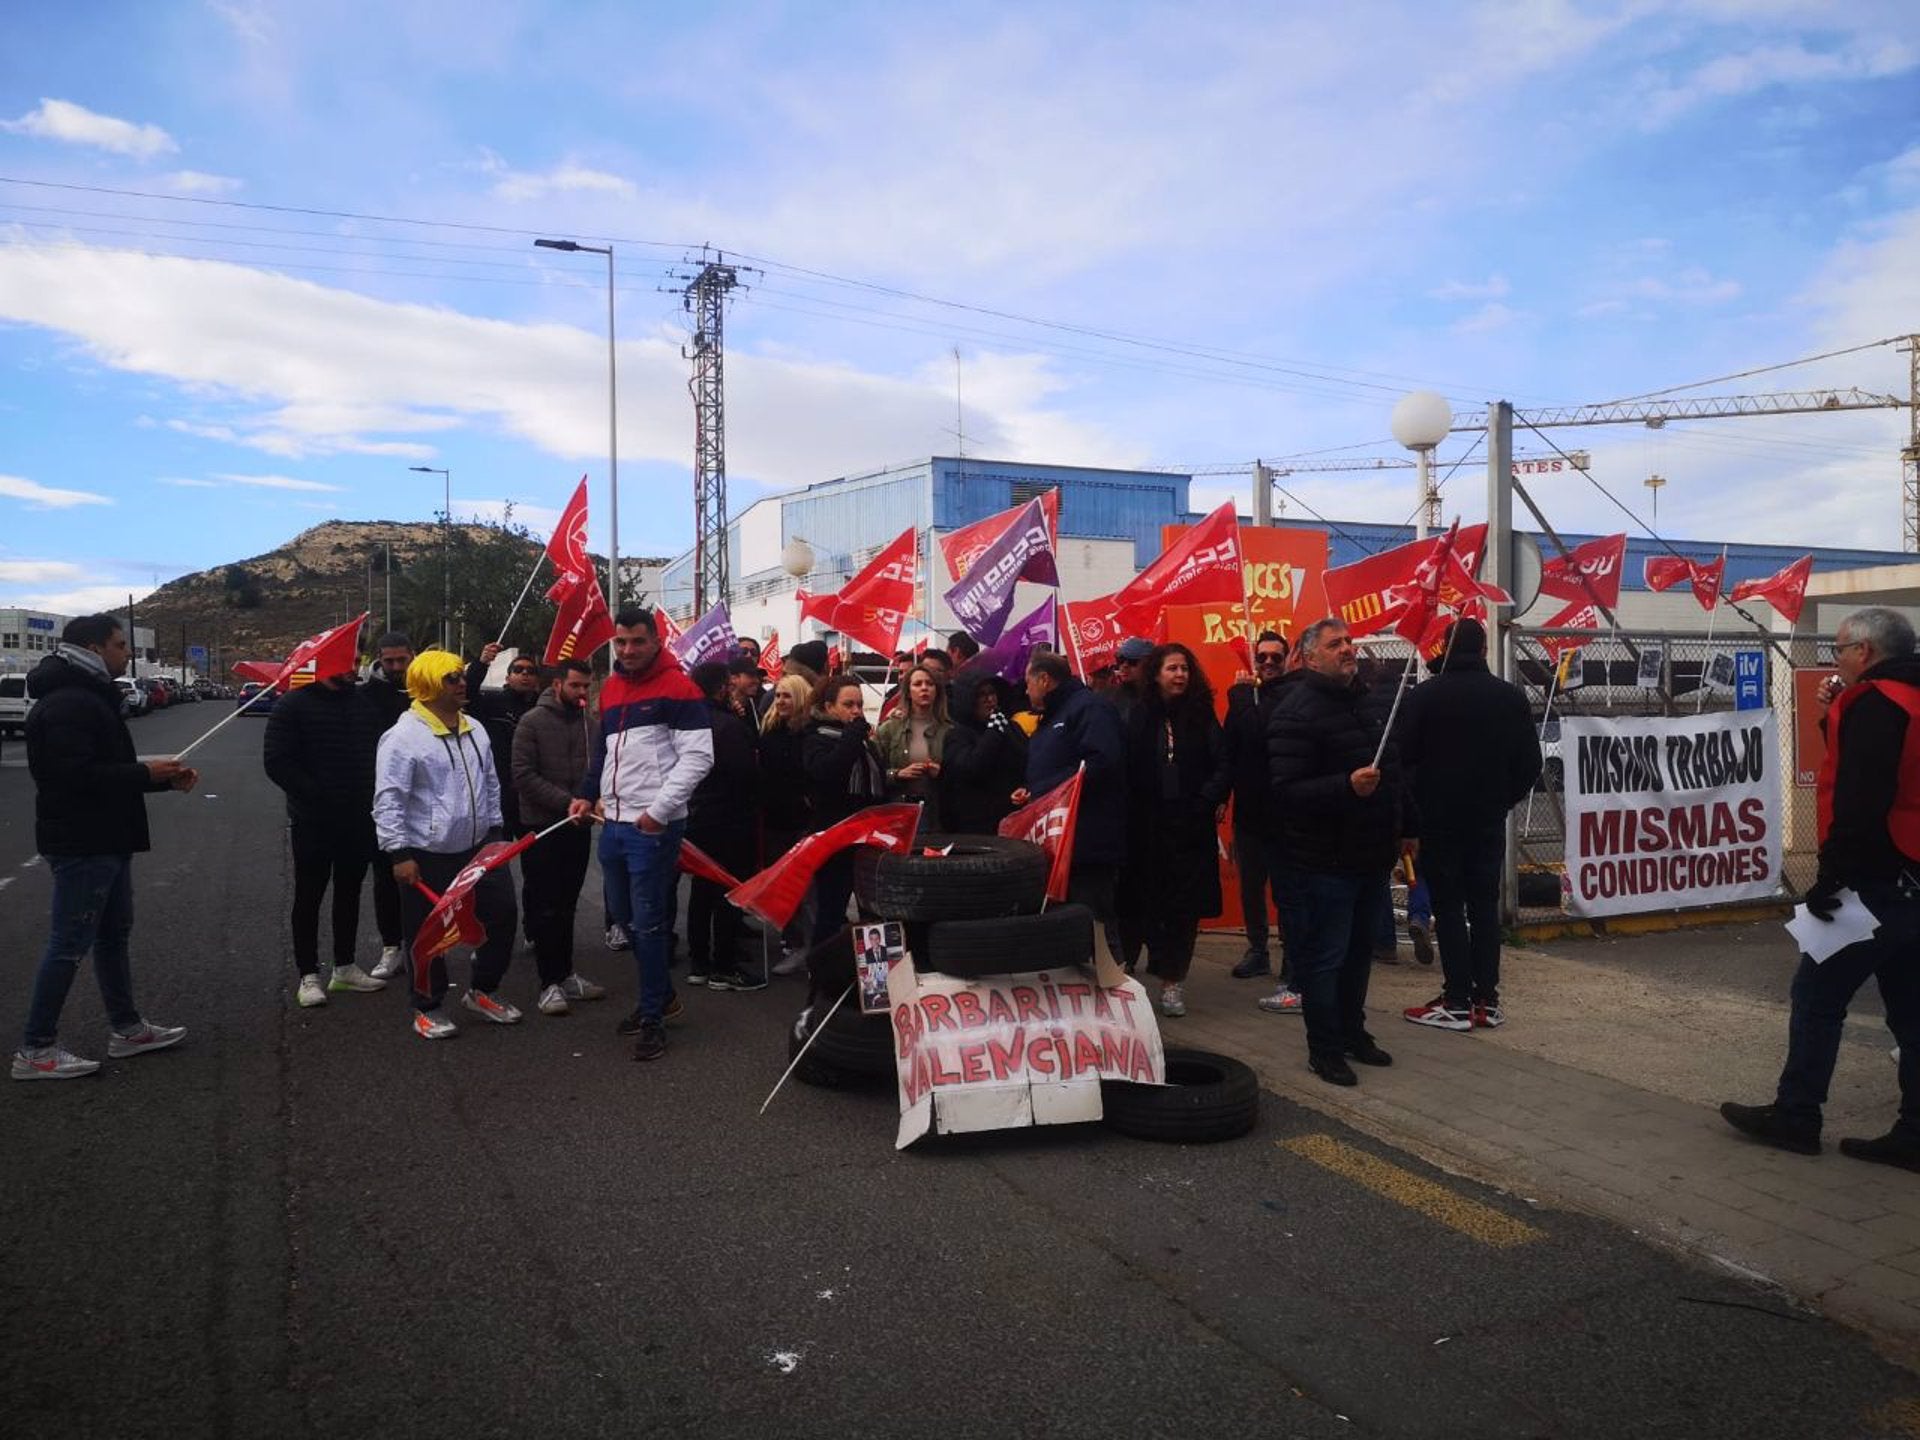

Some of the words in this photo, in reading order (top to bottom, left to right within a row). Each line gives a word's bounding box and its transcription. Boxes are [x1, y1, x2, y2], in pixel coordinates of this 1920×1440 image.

[1511, 461, 1563, 475] ATES
[1578, 735, 1664, 794] MISMO
[1665, 727, 1763, 791] TRABAJO
[1580, 798, 1766, 857] MISMAS
[1580, 846, 1769, 901] CONDICIONES
